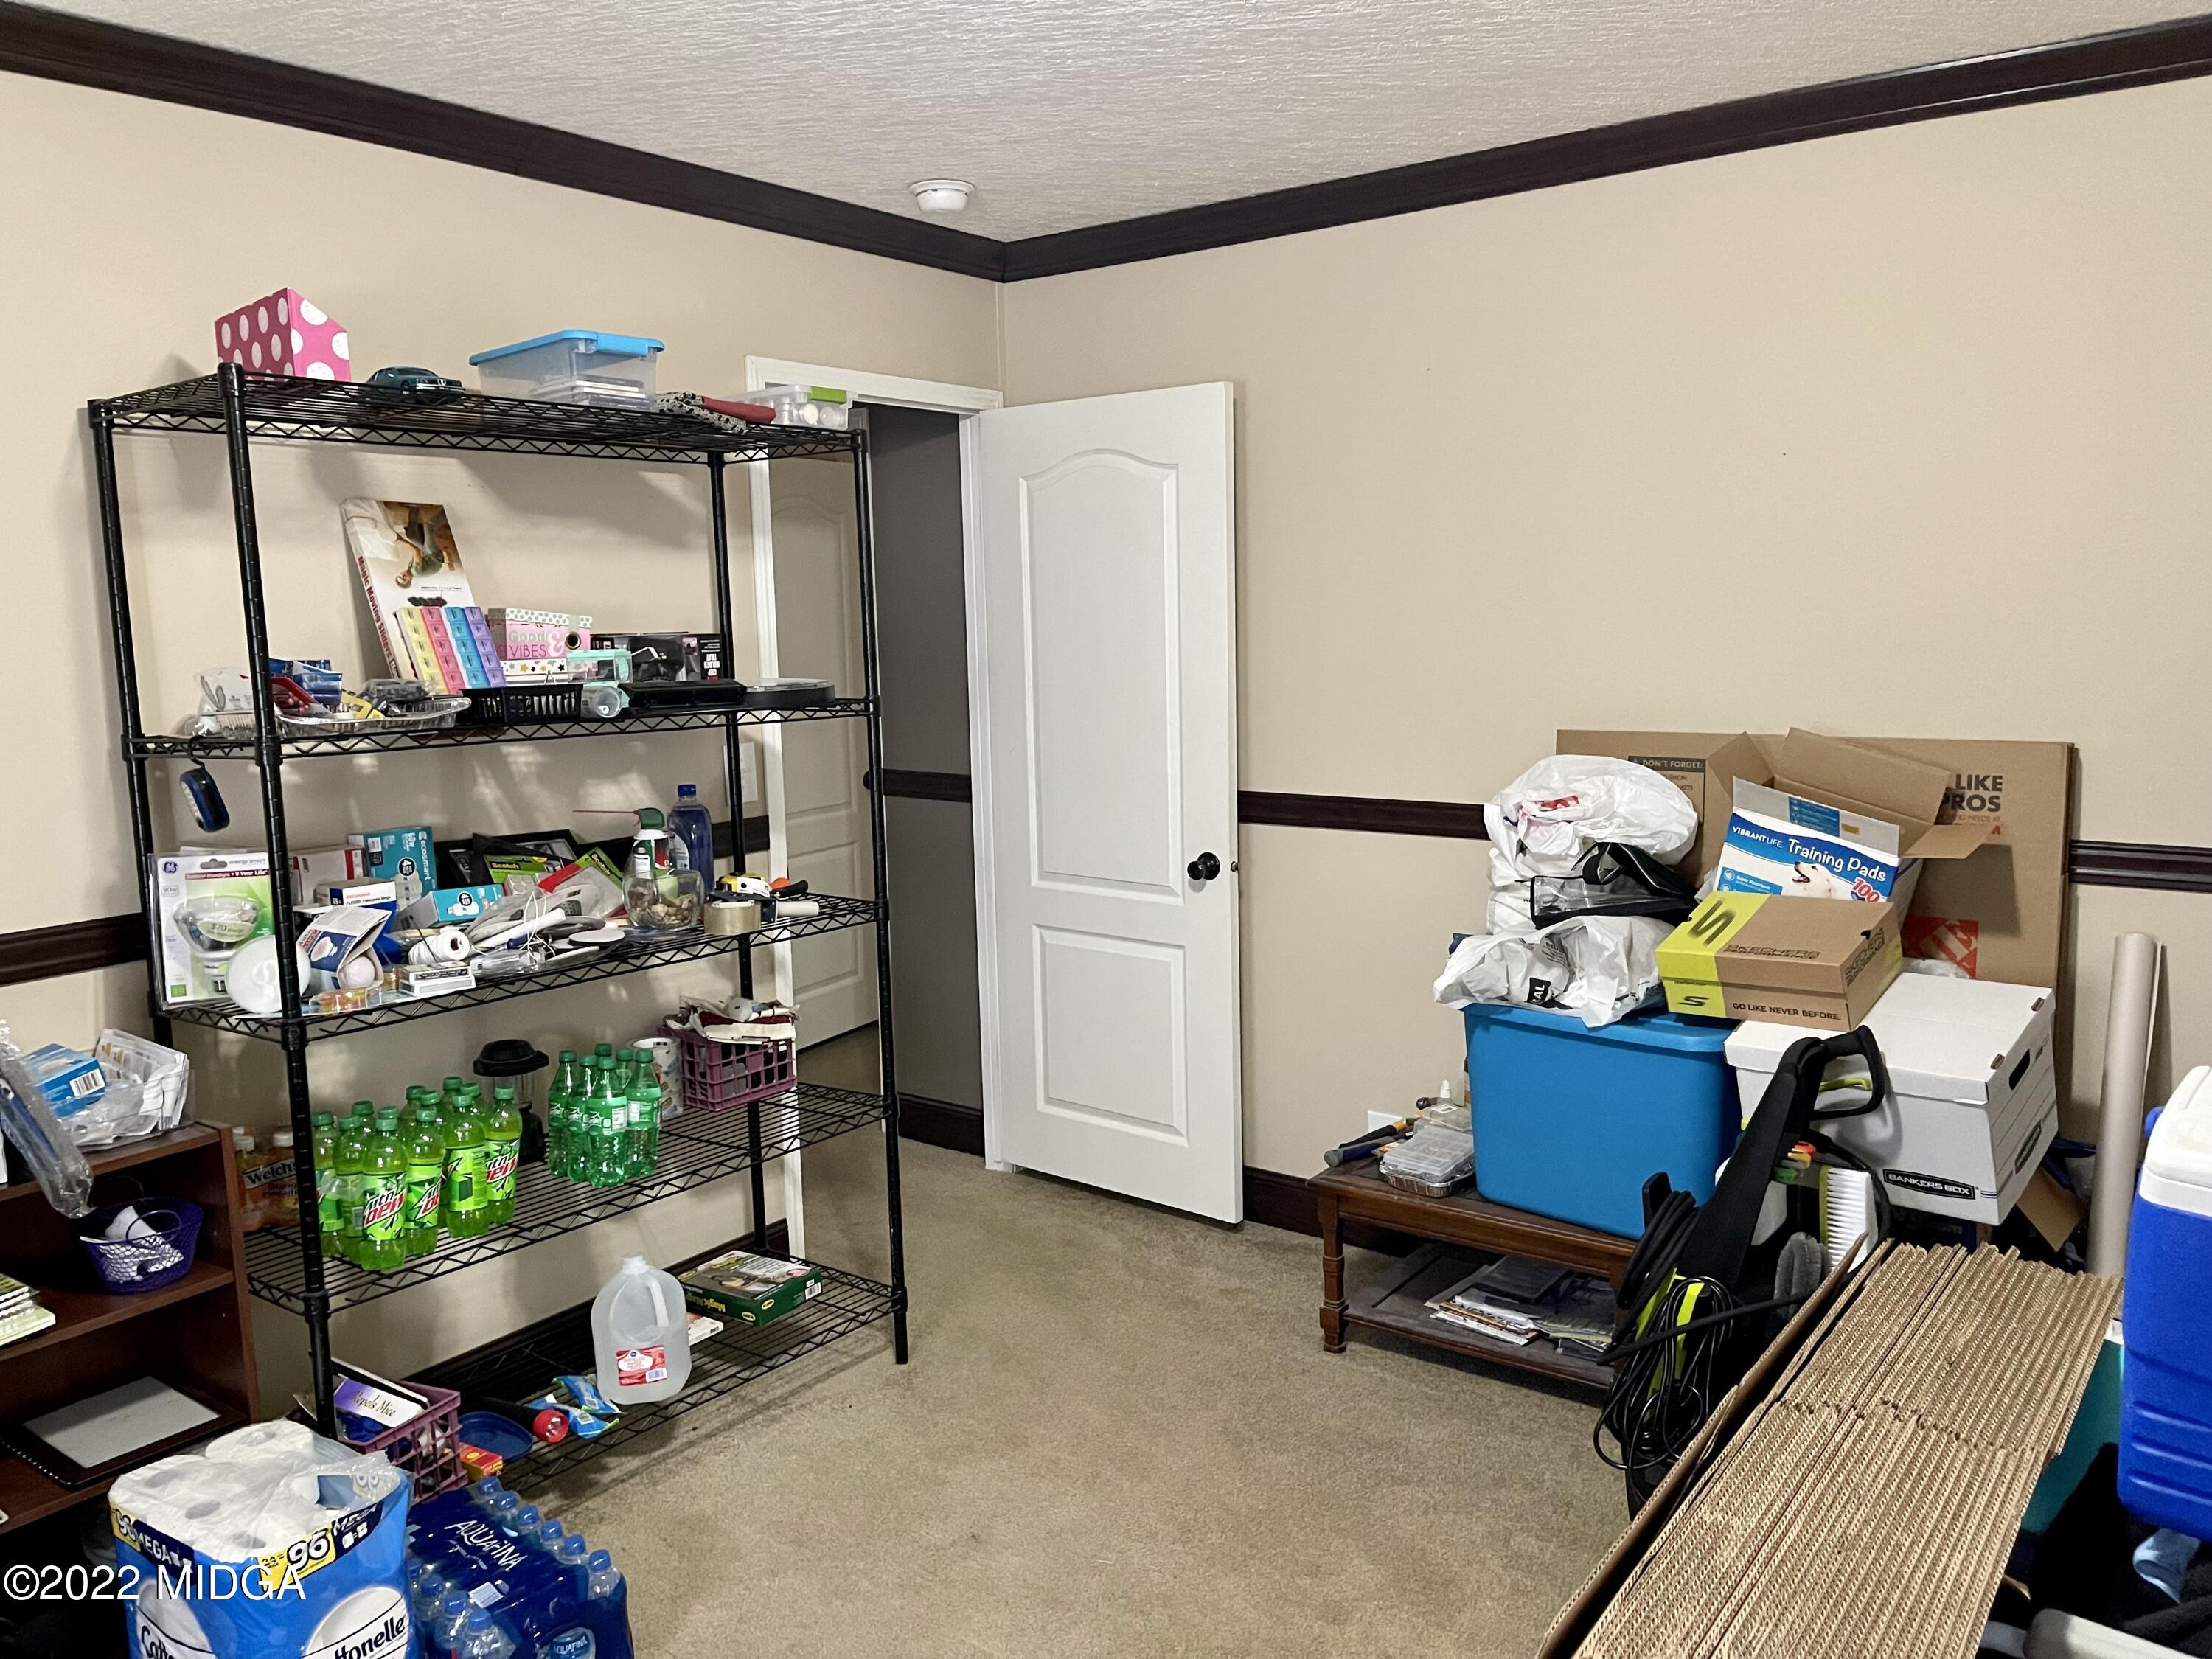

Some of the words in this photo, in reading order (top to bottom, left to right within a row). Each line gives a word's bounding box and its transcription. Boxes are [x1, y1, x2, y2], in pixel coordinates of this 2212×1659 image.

[358, 556, 370, 587] Magic
[366, 585, 381, 624] Moving
[378, 622, 393, 660] Sliders
[509, 630, 546, 642] Good
[509, 644, 547, 658] VIBES
[1643, 759, 1667, 768] DON'T
[1955, 773, 2003, 791] LIKE
[1732, 826, 1767, 843] VIBRANT
[1766, 837, 1783, 848] LIFE
[420, 840, 431, 880] ecosmart
[491, 862, 520, 870] Scotch
[591, 853, 611, 876] Scotch
[1787, 838, 1845, 872] Training
[1848, 857, 1887, 882] Pads
[1851, 877, 1880, 902] 100
[1725, 944, 1820, 958] SKECHERS
[1733, 1002, 1746, 1010] GO
[1747, 1004, 1767, 1012] LIKE
[1770, 1006, 1799, 1015] NEVER
[1888, 1173, 1944, 1191] BANKERS
[1944, 1184, 1971, 1195] BOX
[351, 1391, 380, 1410] Repels
[376, 1399, 396, 1416] Mice
[287, 1528, 330, 1571] 96
